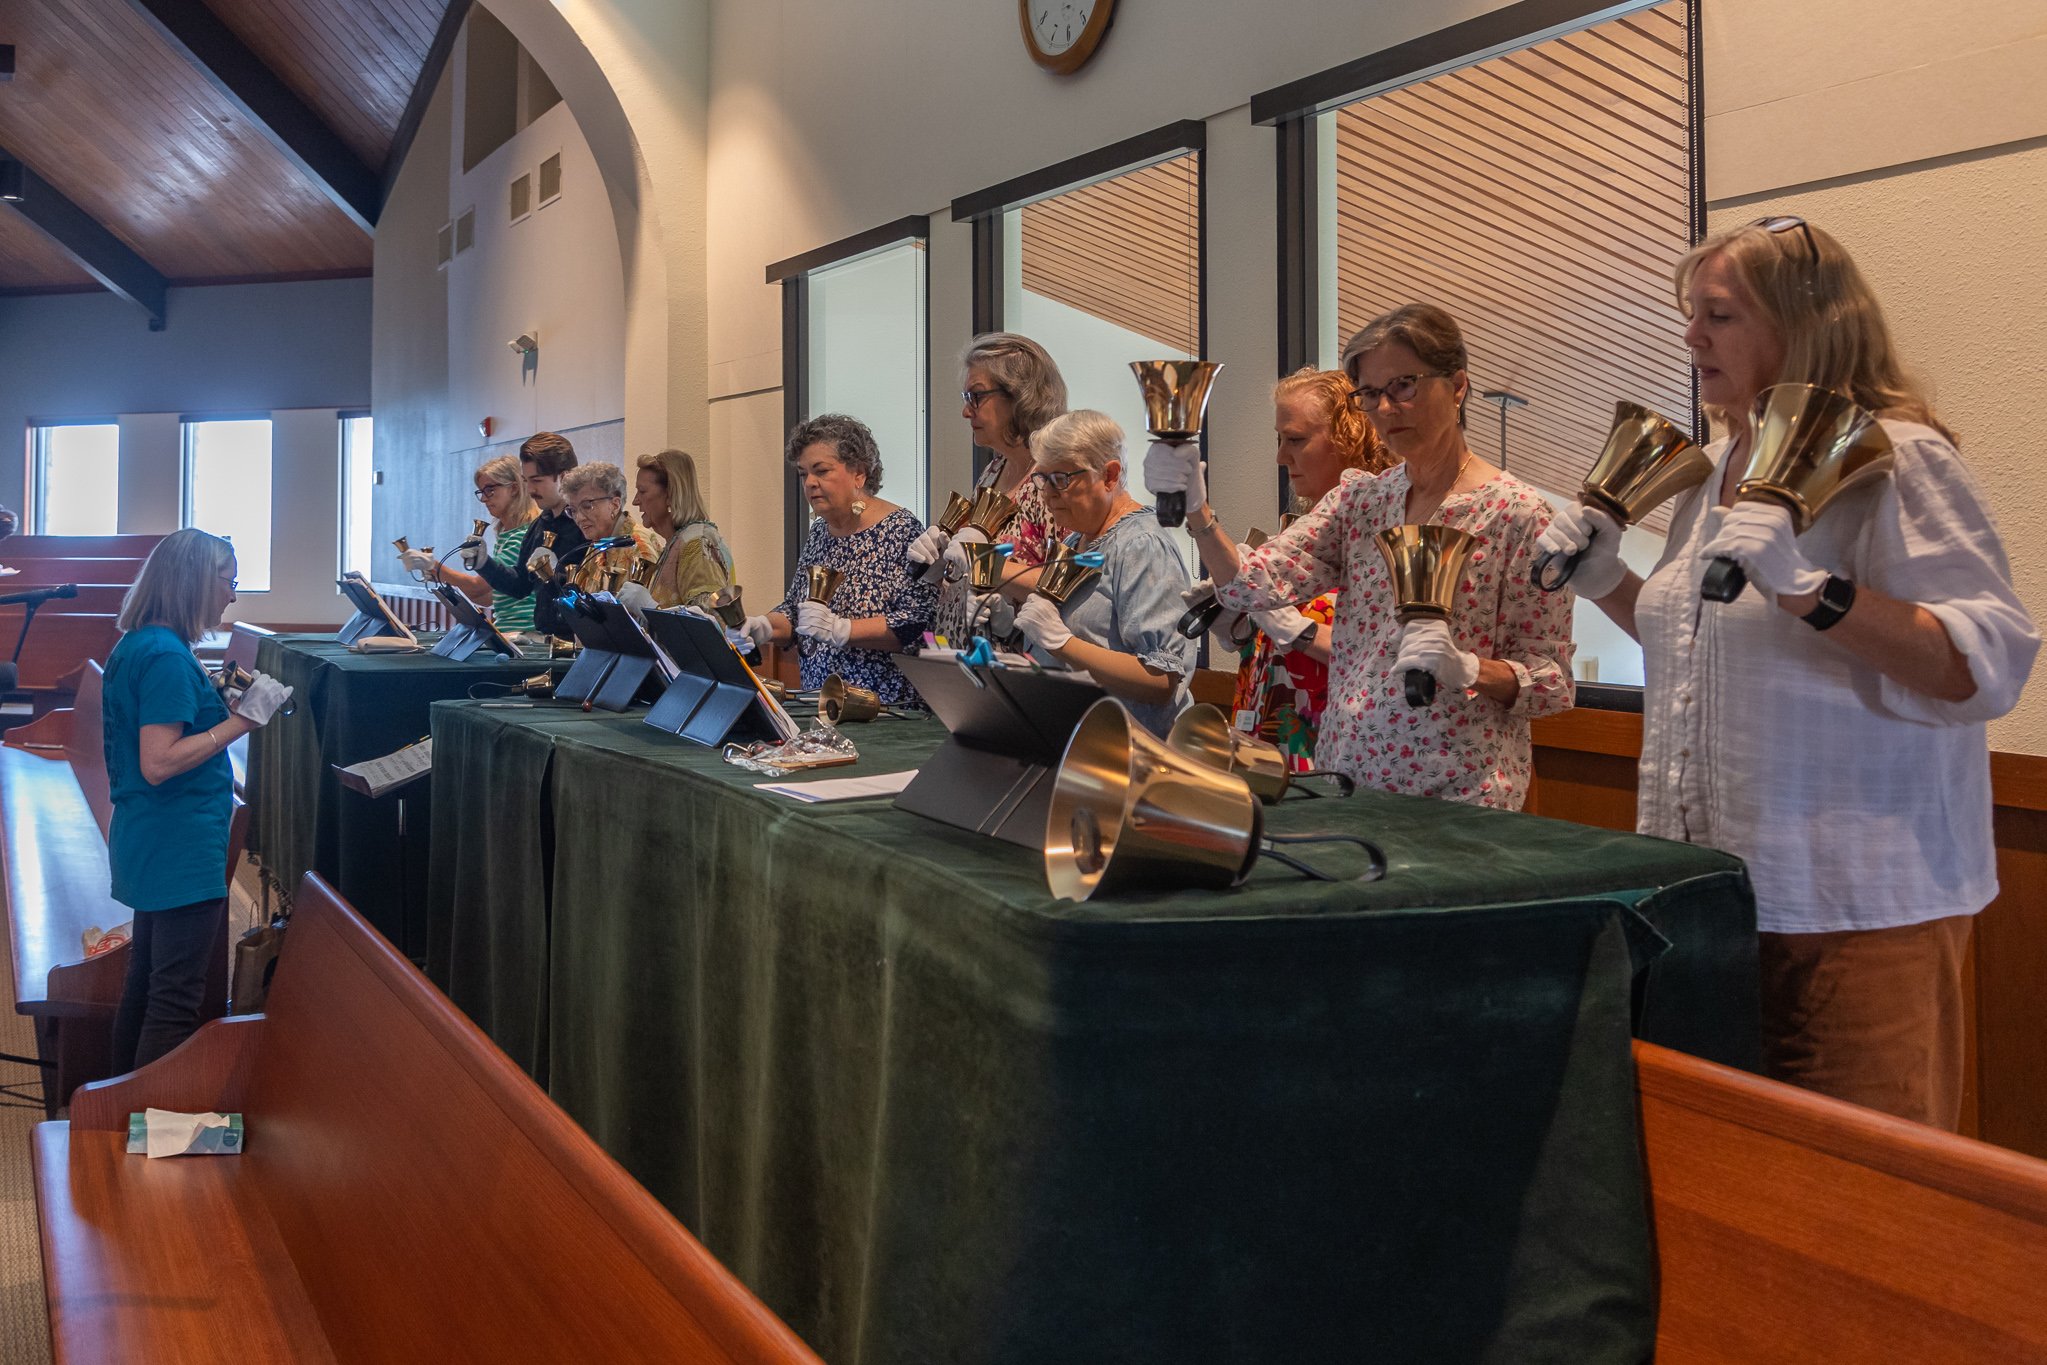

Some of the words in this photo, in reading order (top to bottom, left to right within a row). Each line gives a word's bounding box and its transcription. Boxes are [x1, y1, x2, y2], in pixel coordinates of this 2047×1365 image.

[1040, 10, 1048, 25] 8
[1051, 24, 1058, 41] 7
[1066, 24, 1071, 41] 6
